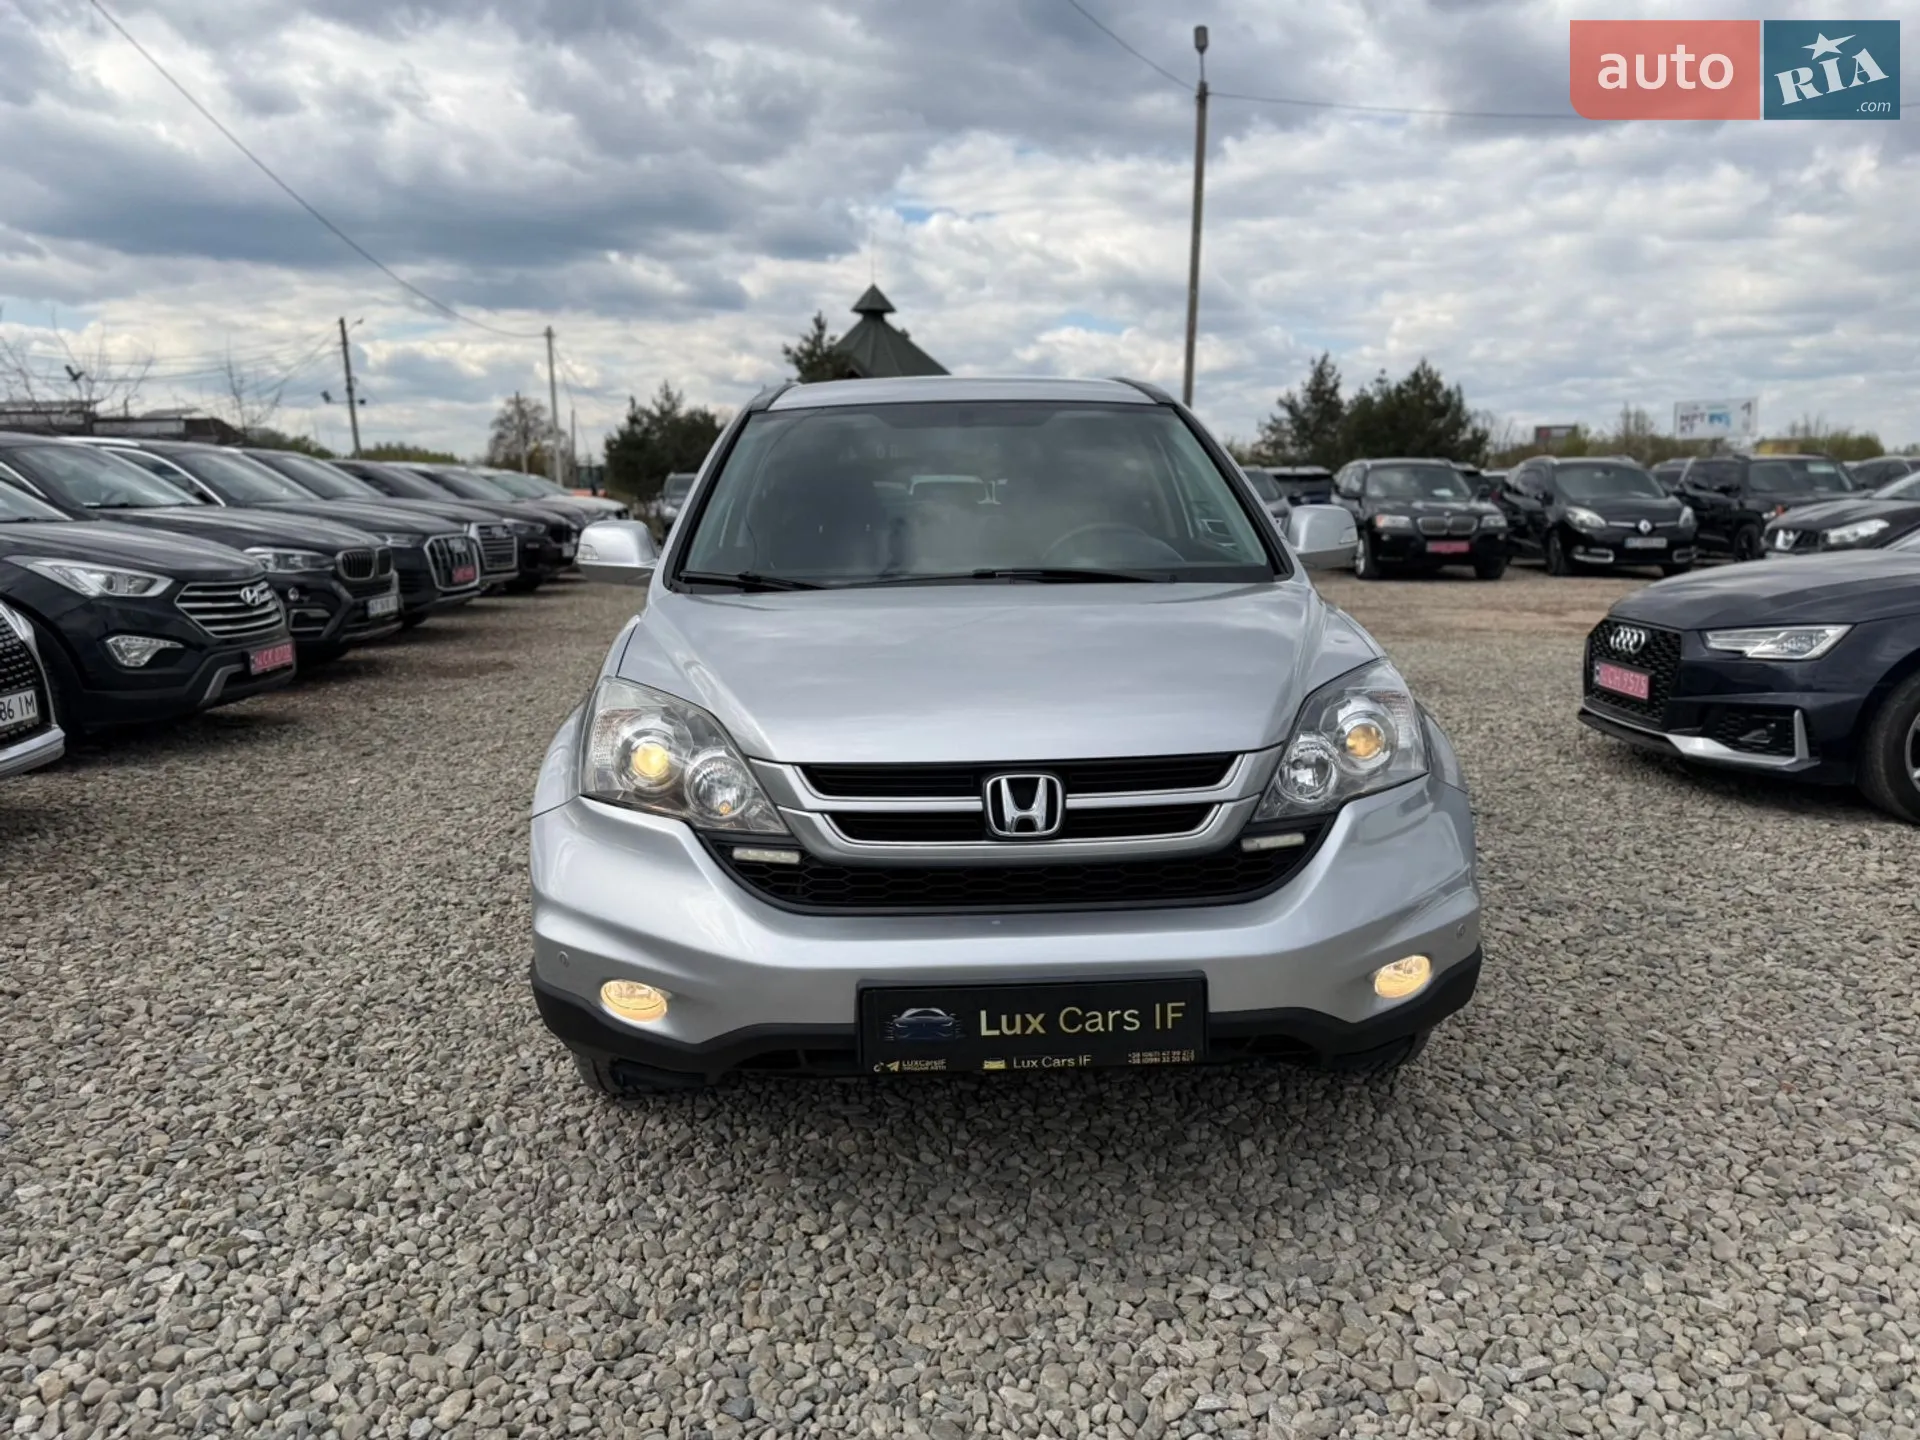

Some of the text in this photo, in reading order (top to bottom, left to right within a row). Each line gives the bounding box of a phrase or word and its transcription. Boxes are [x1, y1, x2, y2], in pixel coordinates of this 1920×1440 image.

[19, 693, 36, 717] IM
[980, 1002, 1186, 1036] Lux Cars IF
[1013, 1054, 1092, 1069] Lux Cars IF
